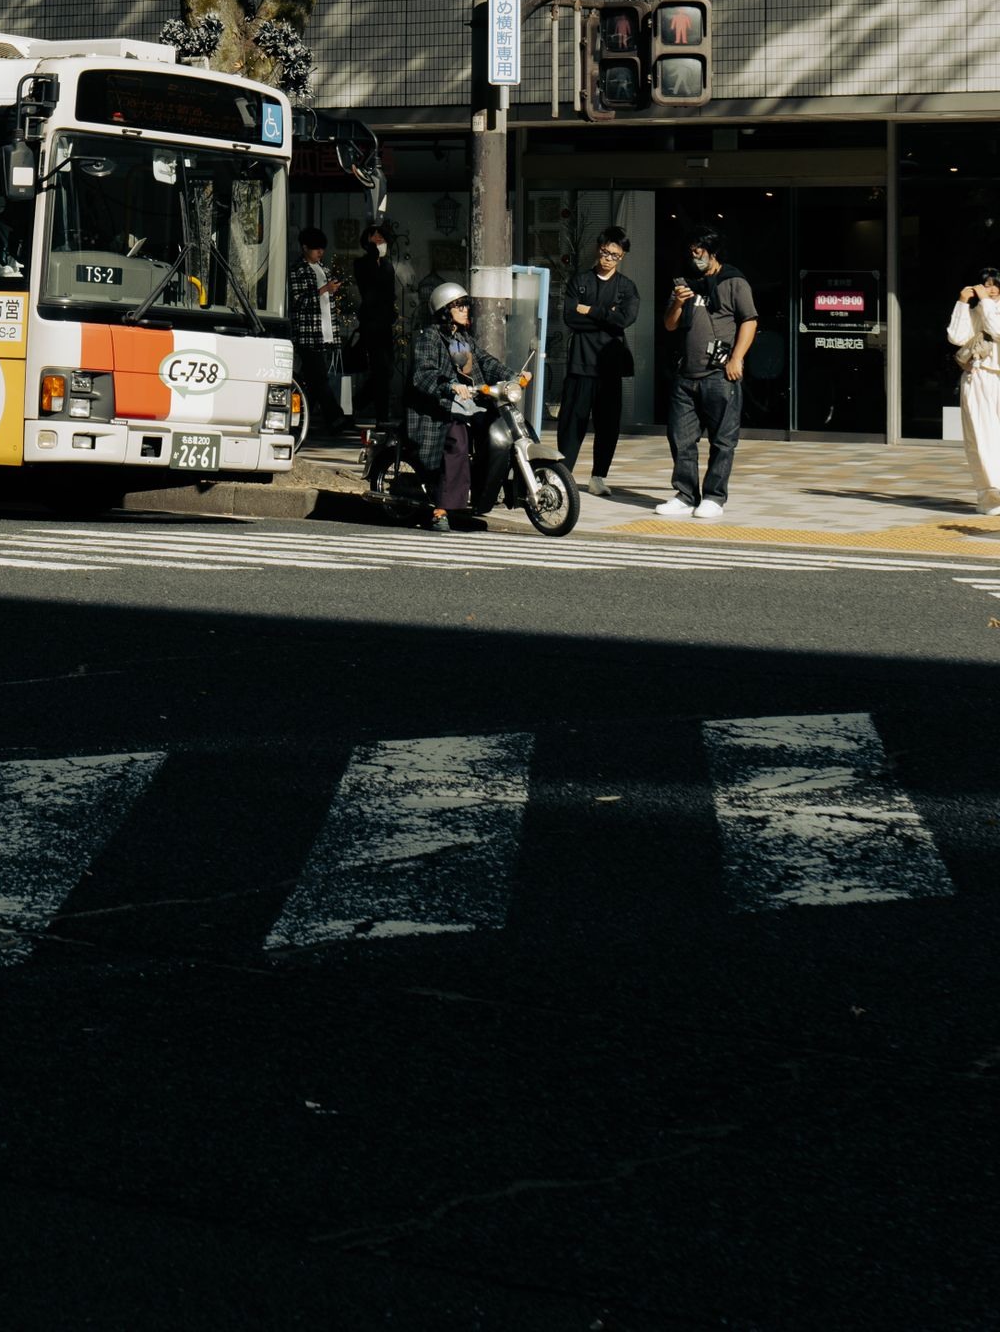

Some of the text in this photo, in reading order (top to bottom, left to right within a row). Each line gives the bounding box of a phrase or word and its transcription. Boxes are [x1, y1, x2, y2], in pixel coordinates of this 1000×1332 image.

[85, 265, 114, 284] TS-2
[168, 358, 219, 385] C-758
[178, 444, 217, 469] 26-61
